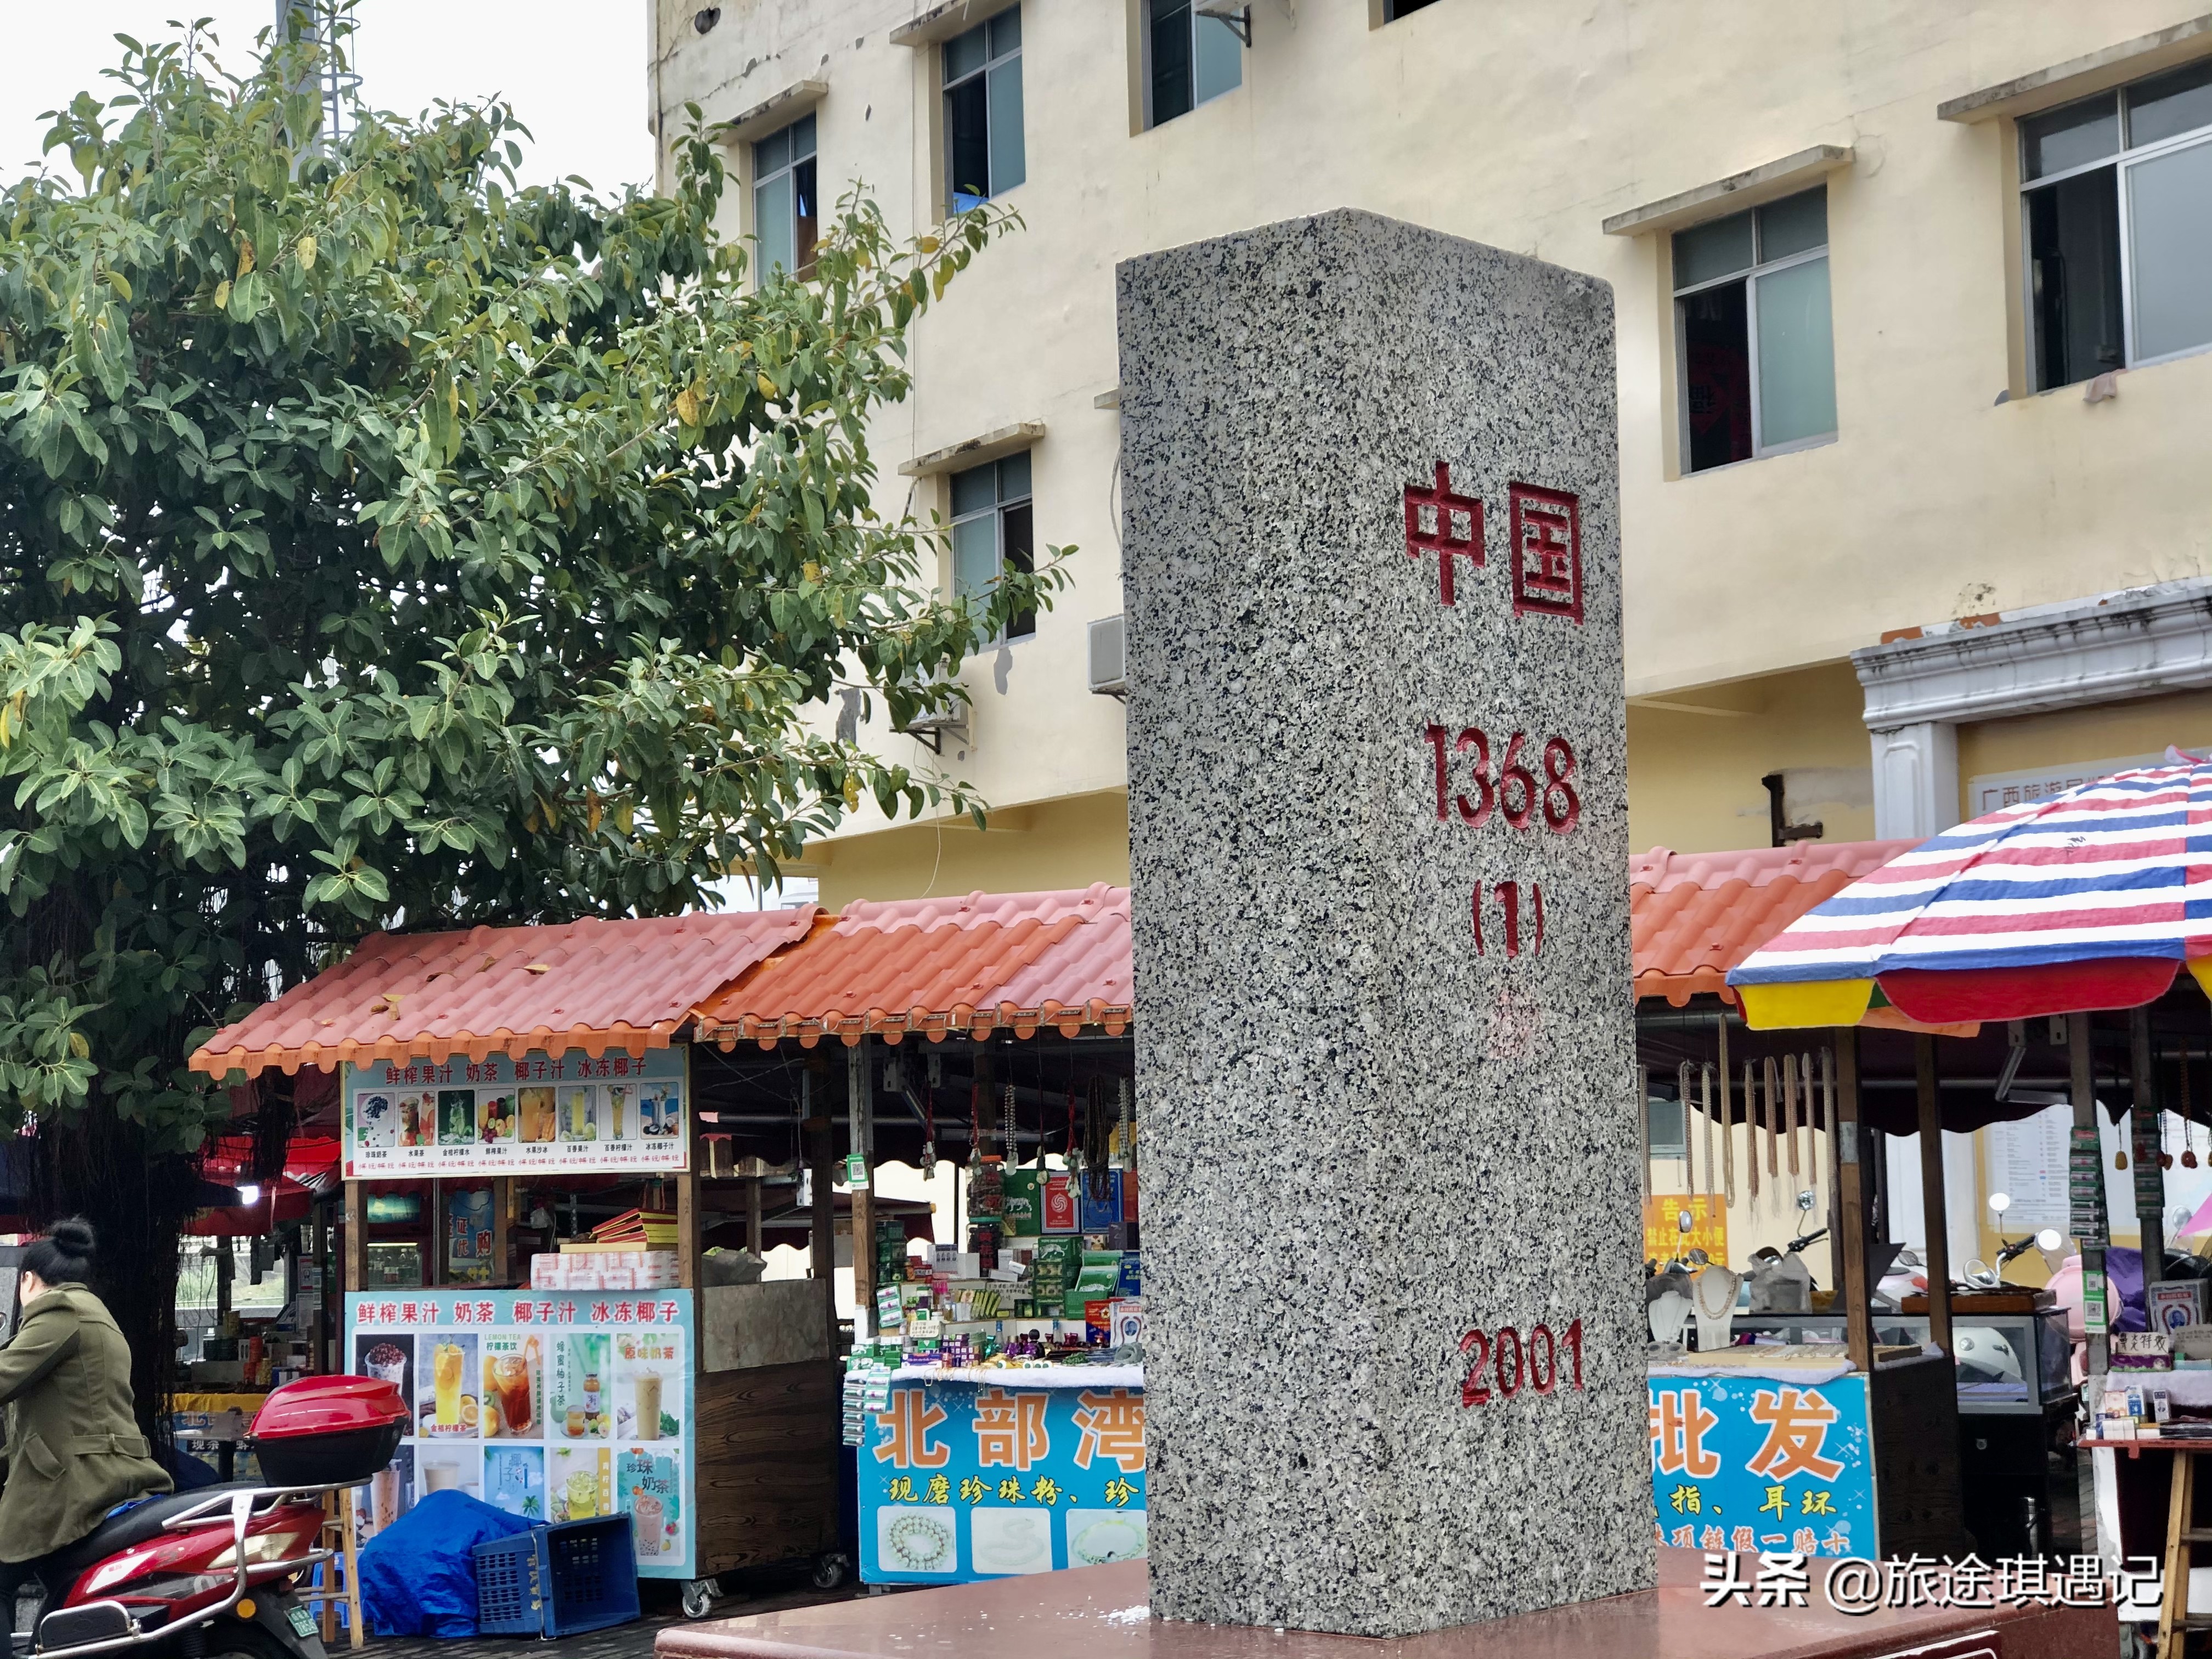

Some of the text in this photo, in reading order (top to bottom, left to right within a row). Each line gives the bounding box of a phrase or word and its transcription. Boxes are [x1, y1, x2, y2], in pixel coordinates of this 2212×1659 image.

[1404, 460, 1584, 625] 中国
[1424, 719, 1580, 834] 1368
[385, 1057, 647, 1085] 鲜榨果汁 奶茶 椰子汁 冰冻椰子
[566, 1144, 589, 1153] 百香果汁
[645, 1142, 674, 1150] 冰冻椰子汁
[1662, 1198, 1707, 1221] 告示
[357, 1300, 679, 1323] 鲜榨果汁 奶茶 椰子汁 冰冻椰子
[486, 1342, 517, 1351] 柠檬茶饮
[624, 1346, 674, 1359] 原味奶茶
[556, 1341, 565, 1406] 蜂蜜柚子茶
[1460, 1318, 1583, 1409] 2001
[873, 1388, 1845, 1483] 北部湾 批发
